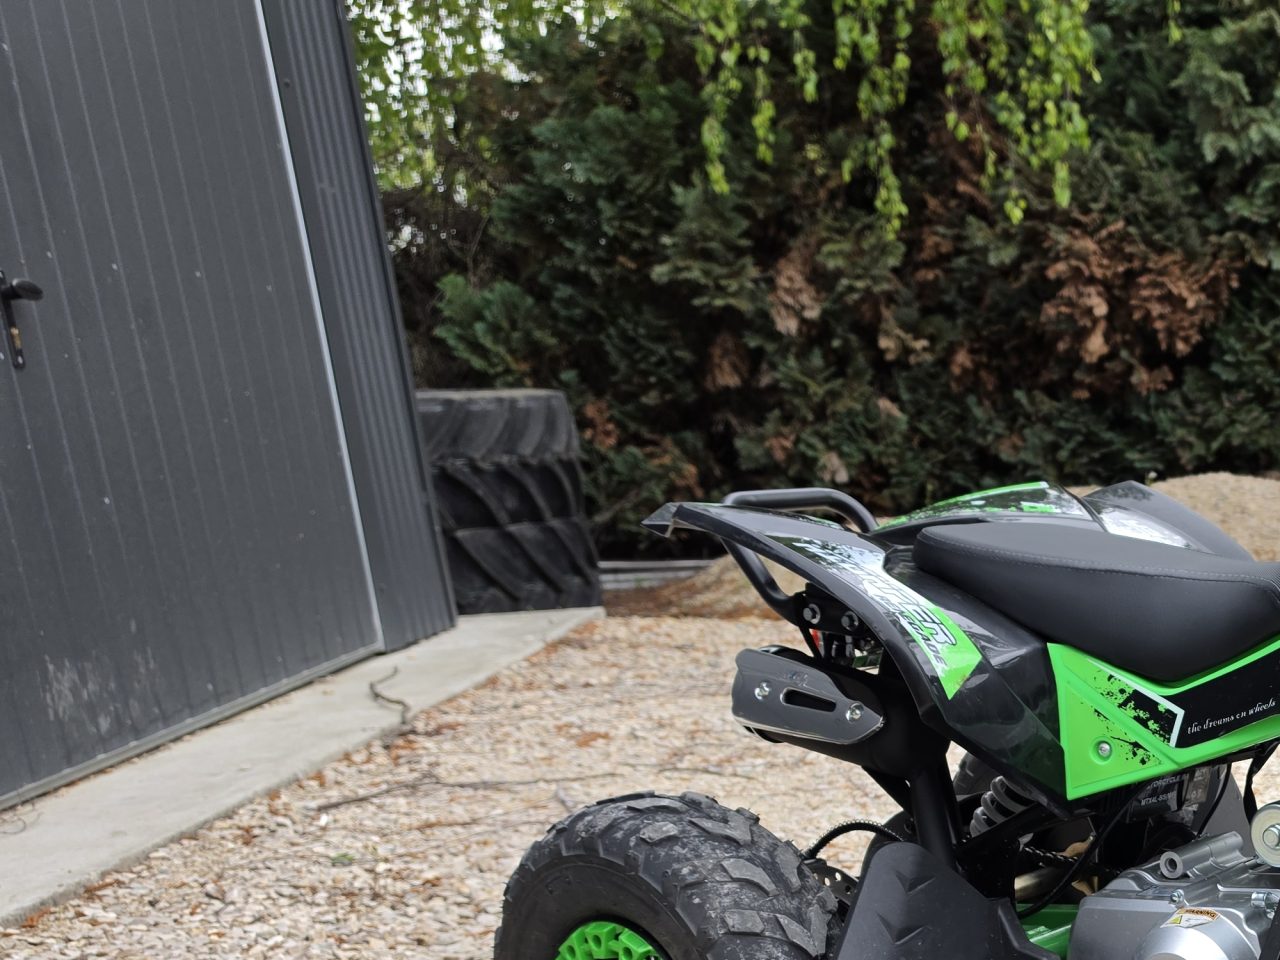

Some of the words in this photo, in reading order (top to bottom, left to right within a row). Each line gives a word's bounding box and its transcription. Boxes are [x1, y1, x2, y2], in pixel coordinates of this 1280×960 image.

[1187, 722, 1202, 735] the
[1203, 716, 1235, 730] dreams
[1248, 697, 1277, 716] wheels
[1185, 908, 1217, 918] WARNING
